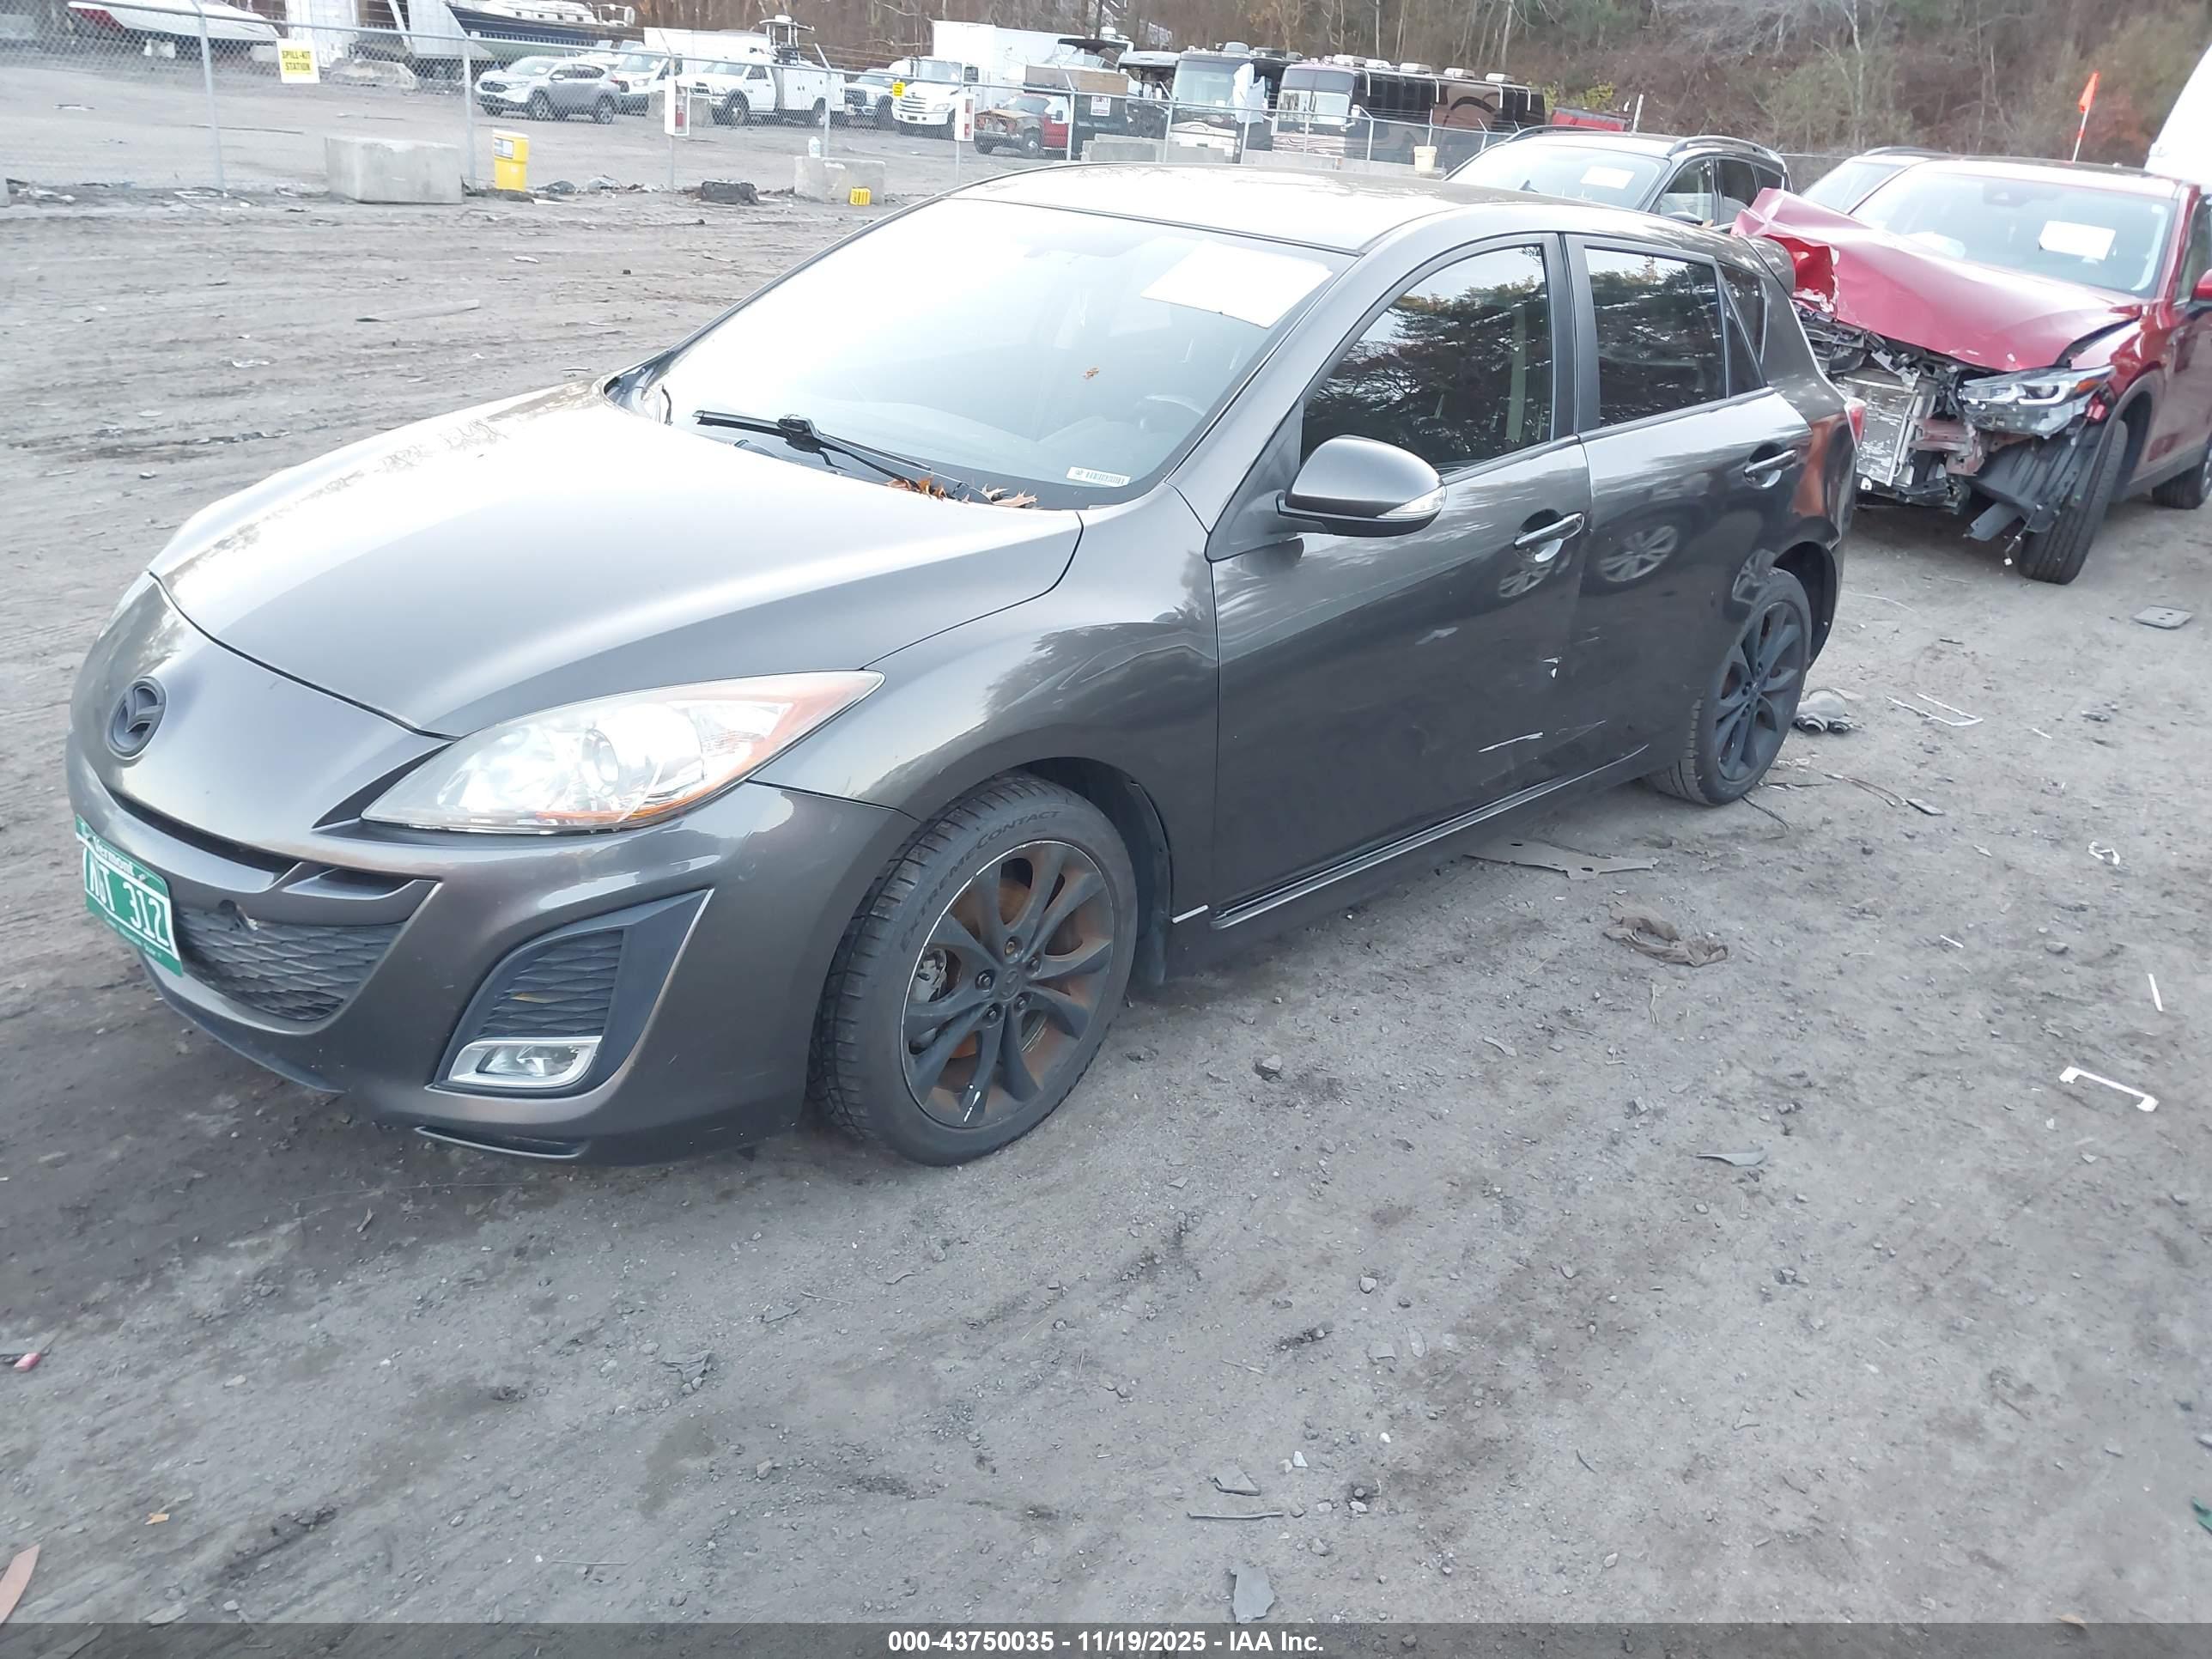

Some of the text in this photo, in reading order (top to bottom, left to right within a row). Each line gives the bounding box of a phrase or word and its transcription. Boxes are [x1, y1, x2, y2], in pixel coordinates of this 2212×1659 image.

[285, 62, 311, 71] STATION
[92, 835, 136, 877] Vermont
[123, 880, 170, 947] 312
